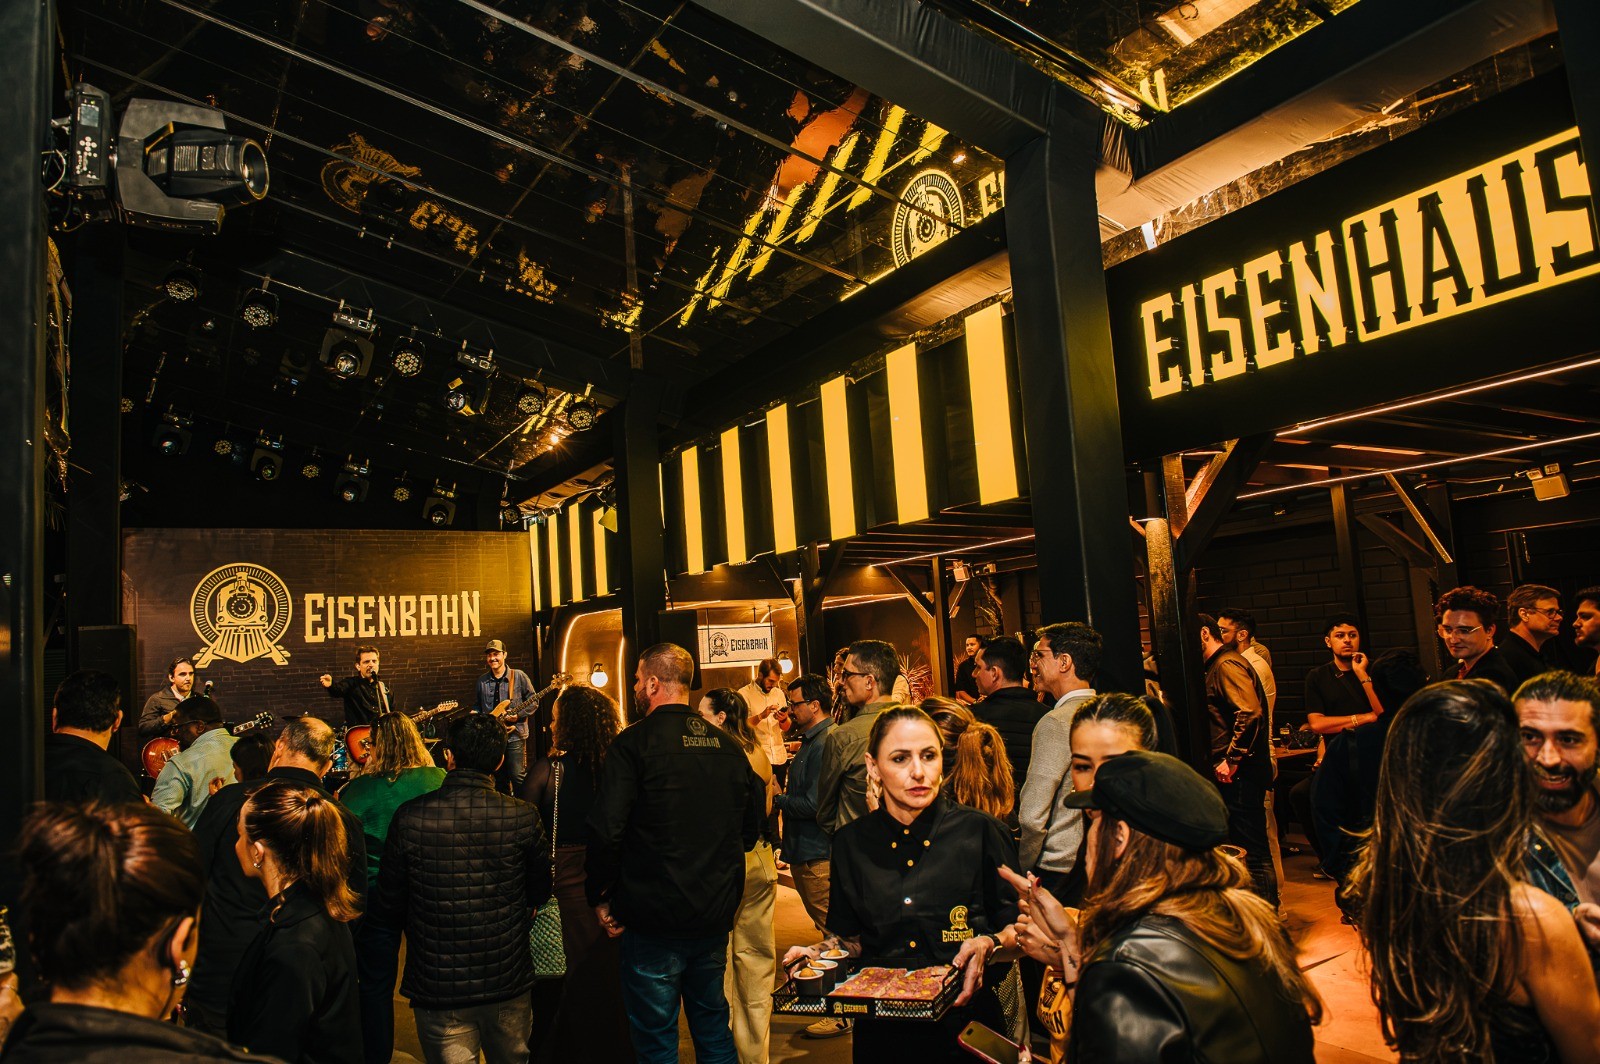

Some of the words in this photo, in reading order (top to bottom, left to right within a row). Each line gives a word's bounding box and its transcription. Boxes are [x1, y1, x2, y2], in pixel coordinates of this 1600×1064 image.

[1140, 136, 1600, 399] EISENHAUS
[304, 590, 481, 643] EISENBAHN
[730, 638, 769, 651] EISENBAHN
[682, 735, 721, 748] EISENBAHN
